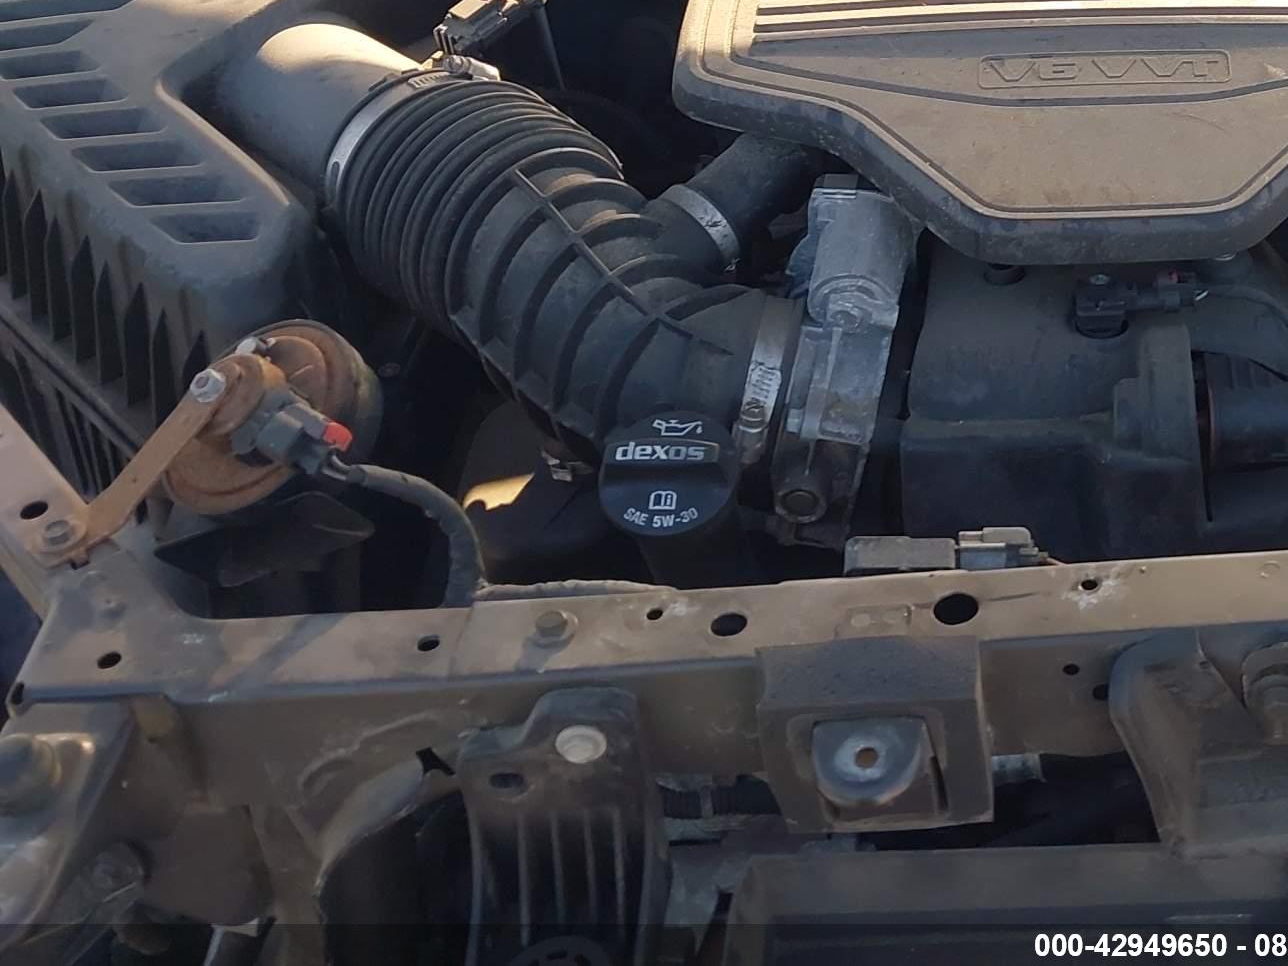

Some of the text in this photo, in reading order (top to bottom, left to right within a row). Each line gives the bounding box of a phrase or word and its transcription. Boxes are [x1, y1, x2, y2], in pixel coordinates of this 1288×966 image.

[988, 57, 1221, 82] V6 VVT
[615, 441, 705, 461] dexos
[623, 507, 698, 528] SAE 5W-30
